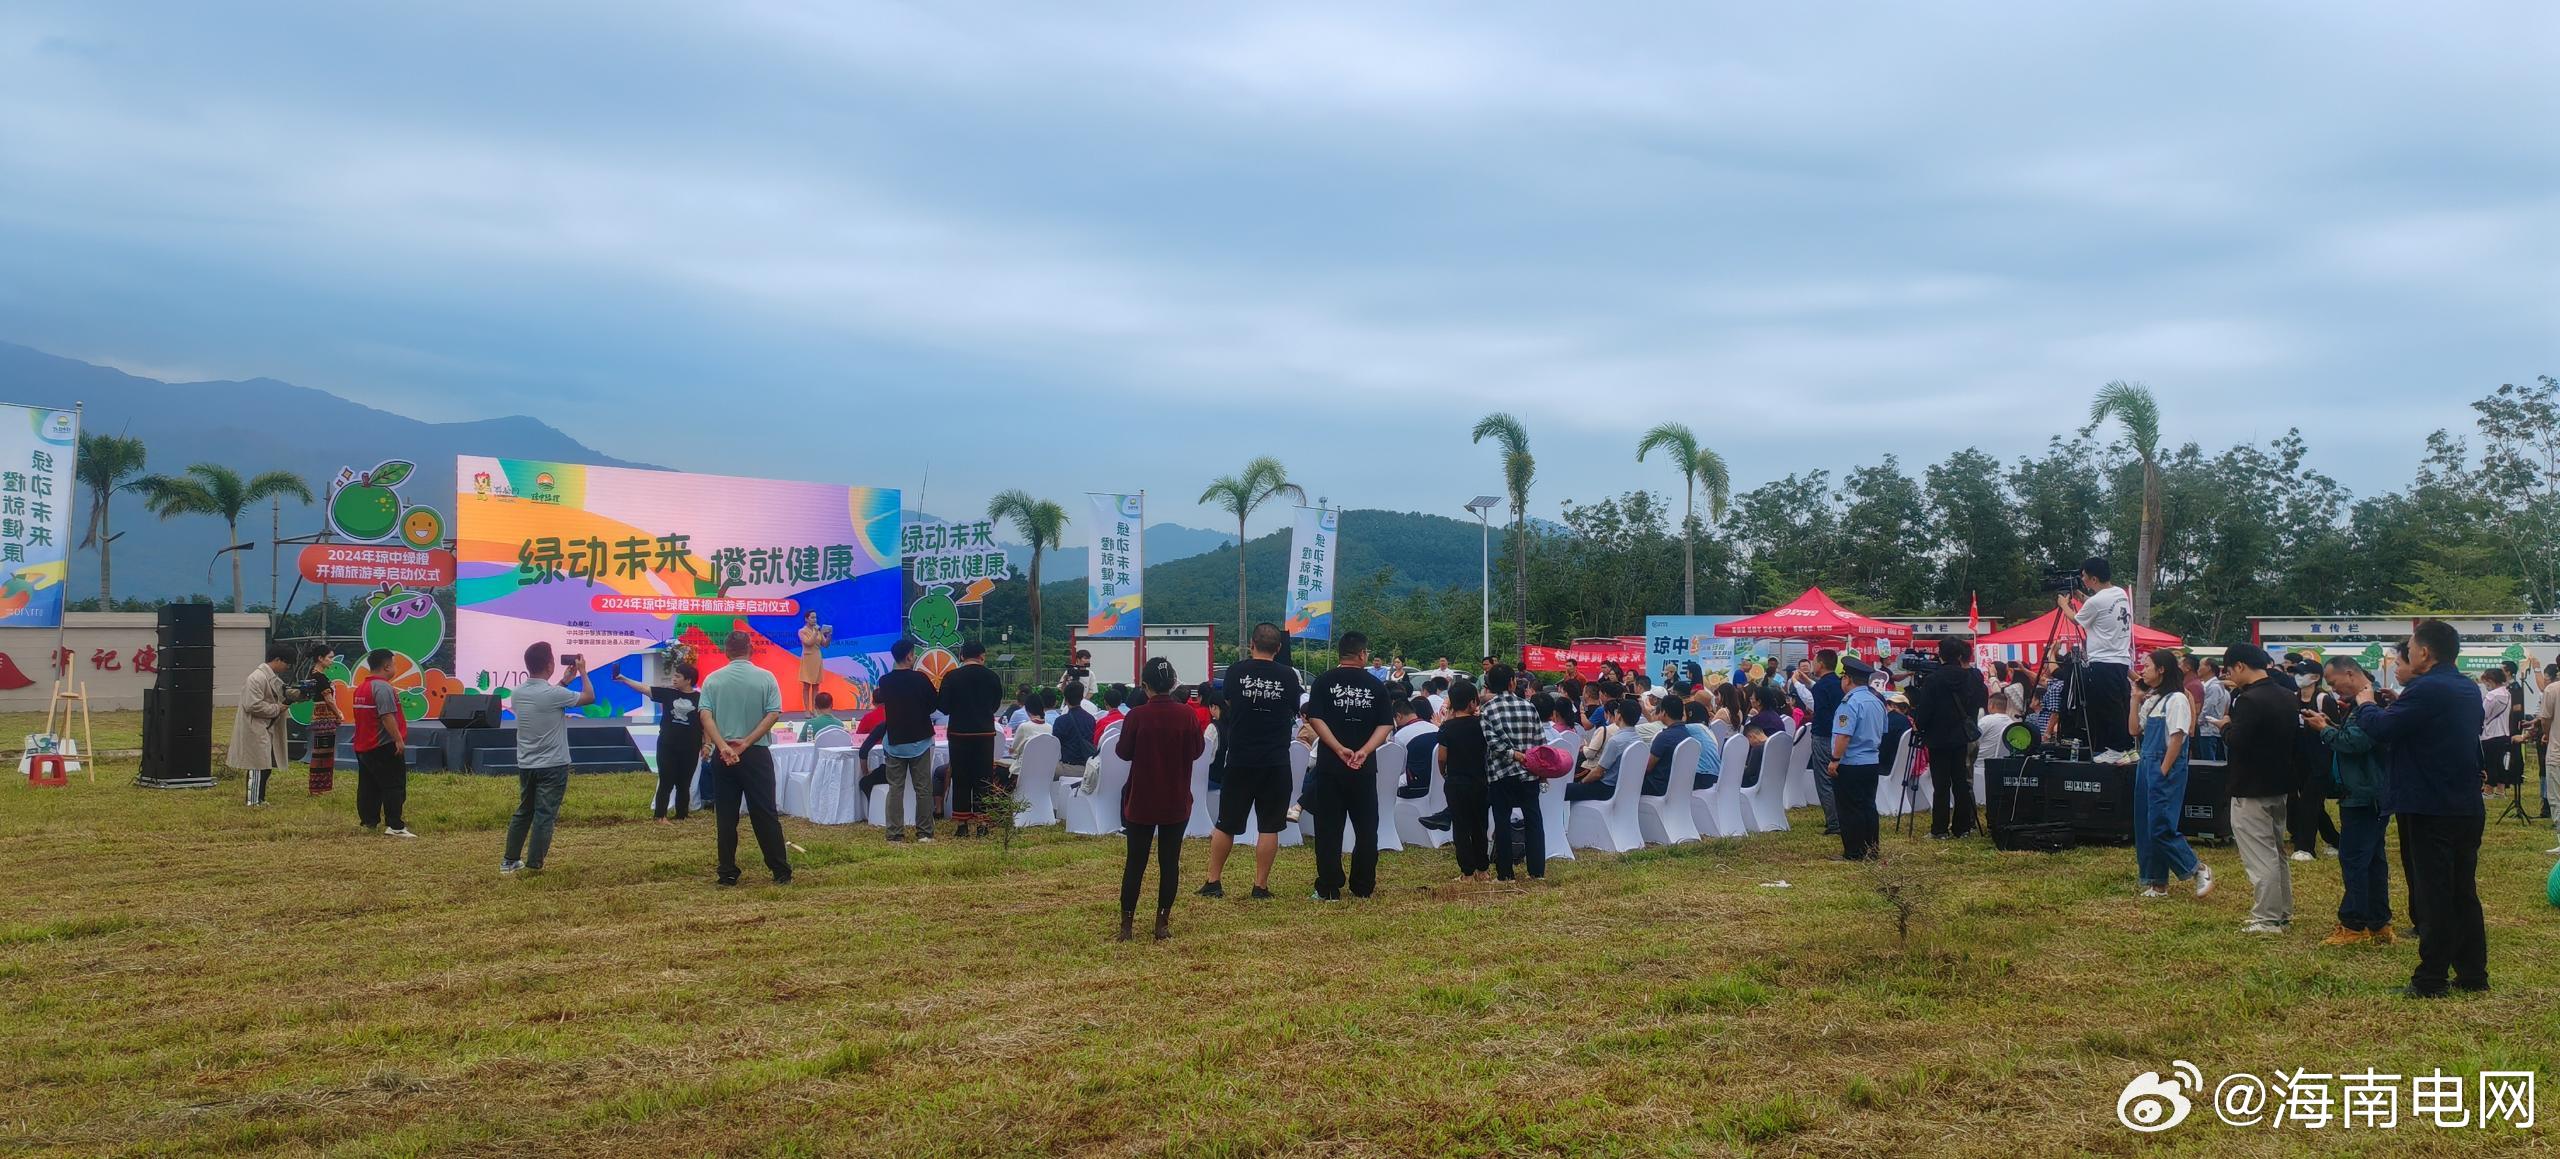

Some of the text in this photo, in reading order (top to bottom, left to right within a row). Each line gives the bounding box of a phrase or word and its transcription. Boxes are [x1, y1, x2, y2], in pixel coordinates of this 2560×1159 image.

[902, 521, 996, 555] 绿动未来
[327, 550, 430, 566] 2024年琼中绿橙
[518, 532, 857, 588] 绿动未来 橙就健康
[316, 564, 441, 582] 开摘旅游季启动仪式
[916, 552, 1008, 582] 橙就健康
[601, 597, 790, 614] 2024年琼中绿橙开摘旅游季启动仪式
[2310, 623, 2361, 633] 宣传栏
[2491, 622, 2545, 633] 宣传栏
[1242, 690, 1282, 704] 回归自然
[1333, 698, 1372, 714] 回归自然
